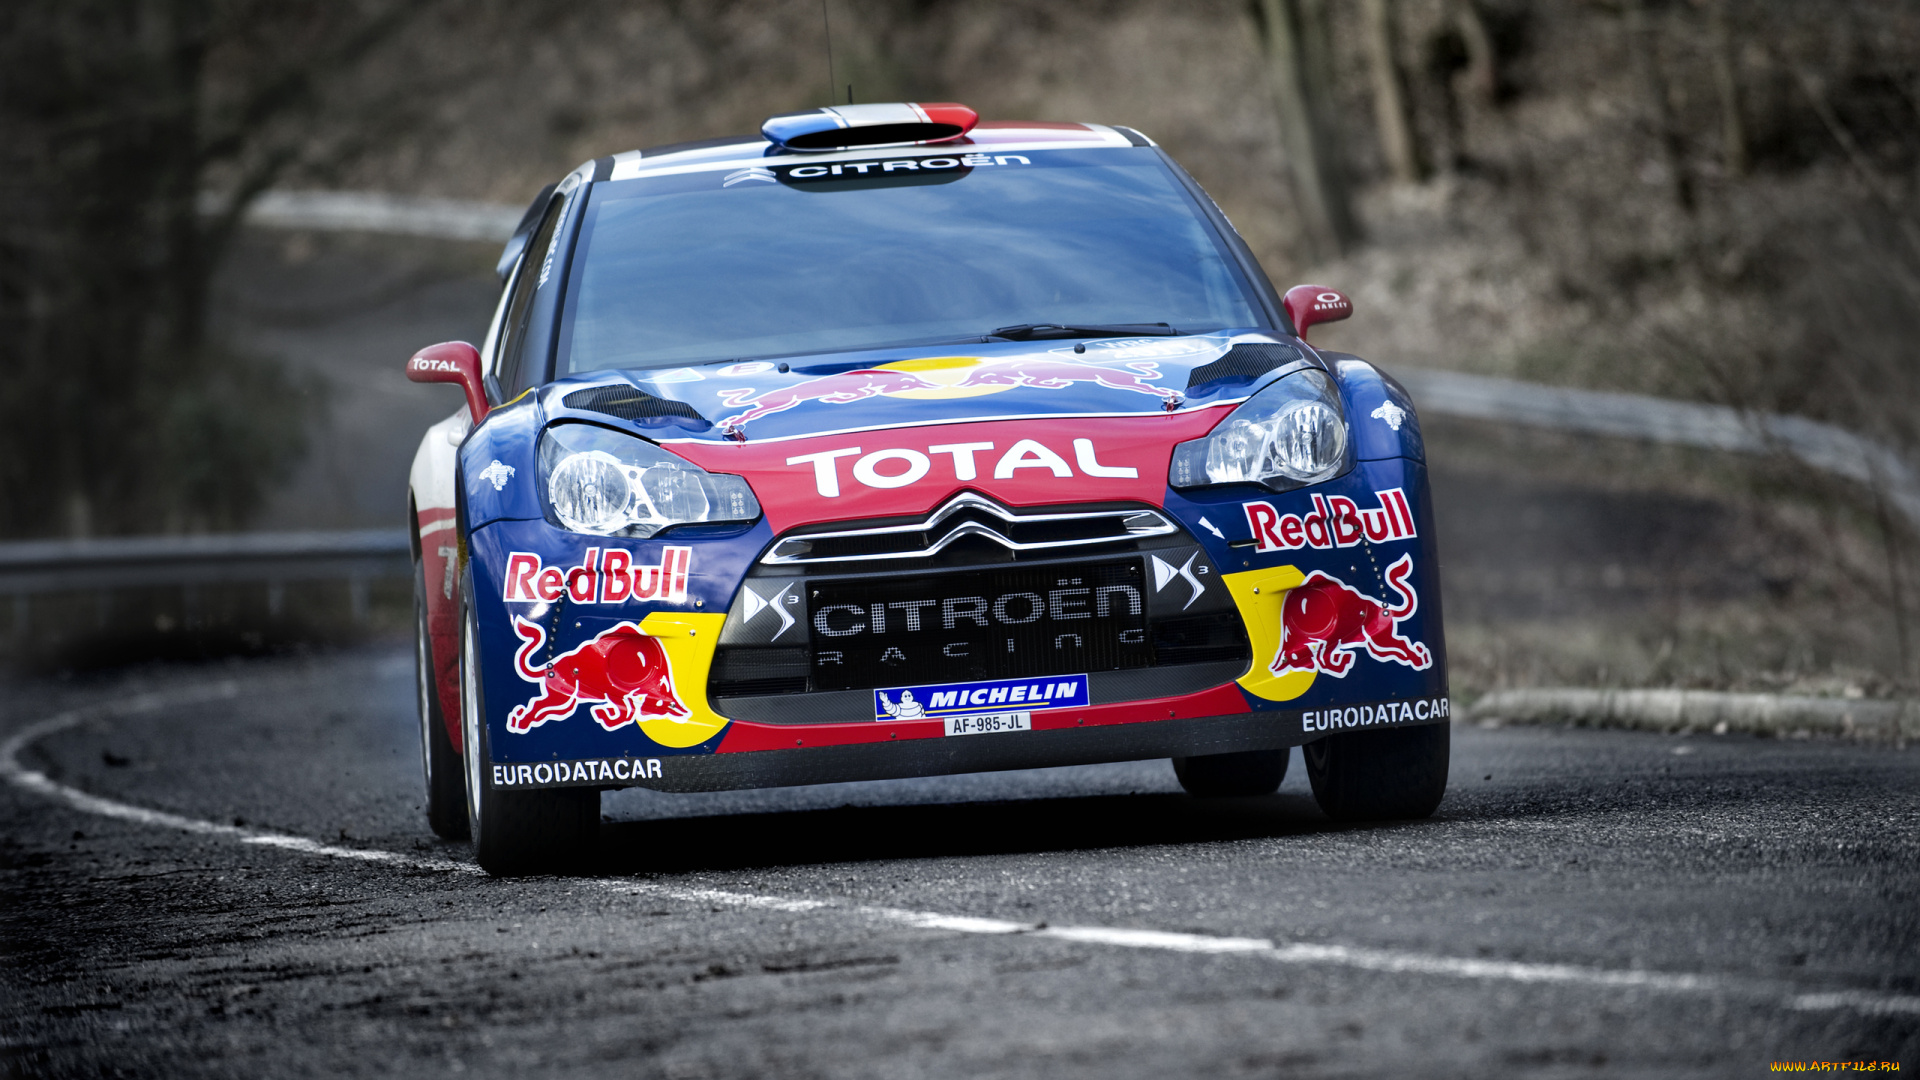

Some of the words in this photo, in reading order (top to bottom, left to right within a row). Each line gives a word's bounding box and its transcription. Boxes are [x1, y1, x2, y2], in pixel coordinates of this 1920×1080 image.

[789, 153, 1031, 178] CITROËN
[1314, 302, 1347, 311] OAKLEY
[413, 357, 461, 372] TOTAL
[786, 438, 1139, 498] TOTAL
[813, 577, 1142, 637] CITROËN
[817, 629, 1145, 666] RACING
[929, 682, 1079, 708] MICHELIN
[953, 719, 1023, 734] AF-985-JL
[1303, 698, 1449, 732] EURODATACAR
[493, 759, 663, 786] EURODATACAR
